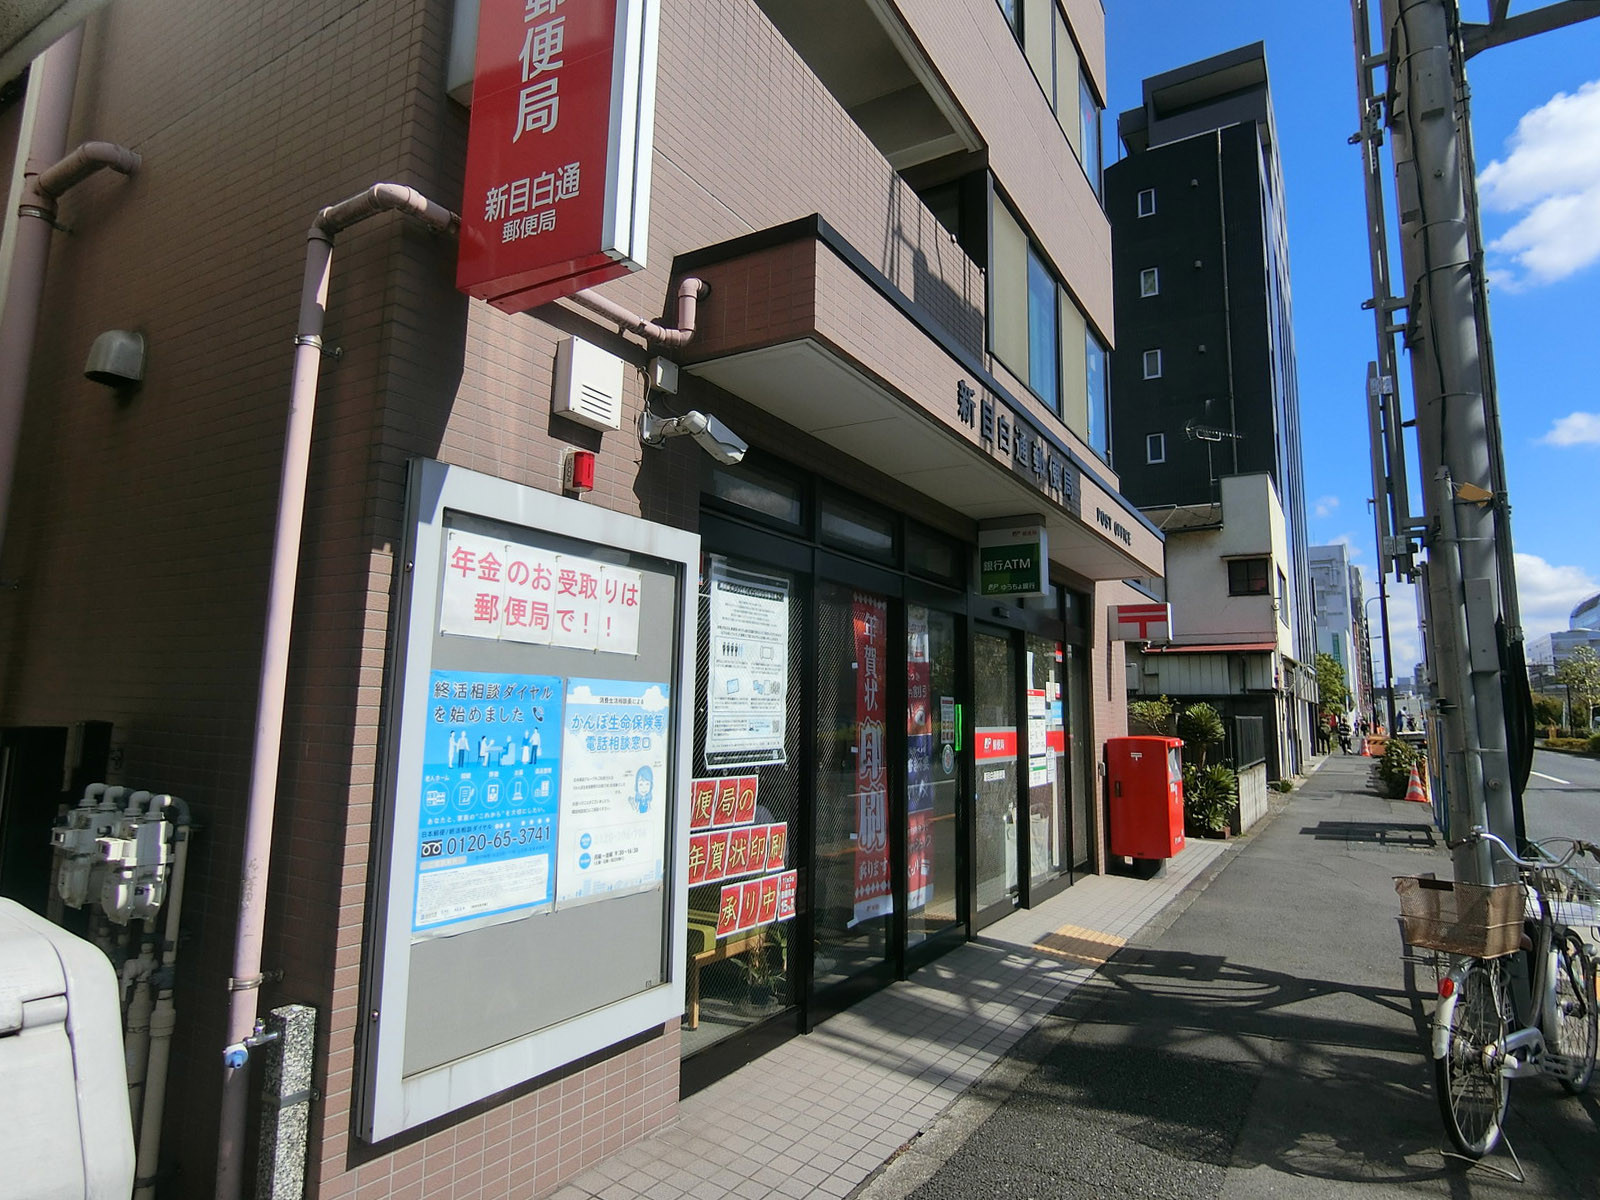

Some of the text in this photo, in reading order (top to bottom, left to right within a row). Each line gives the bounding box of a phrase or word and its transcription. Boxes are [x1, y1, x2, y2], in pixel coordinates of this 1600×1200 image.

[484, 161, 581, 223] 新目白通
[501, 209, 557, 244] 郵便局
[957, 379, 1074, 502] 新目白通郵便局
[1096, 506, 1132, 546] POST OFFICE
[450, 546, 639, 607] 年金のお受取りは
[983, 558, 1031, 571] 銀行ATM
[1000, 582, 1036, 591] ゆうちょ銀行
[433, 680, 553, 701] 終活相談ダイヤル
[434, 706, 524, 723] を始めました
[571, 714, 664, 731] かんぽ生命保険等
[586, 735, 651, 752] 電話相談窓口
[692, 788, 754, 819] 便局の
[447, 826, 551, 855] 0120-65-3741
[689, 832, 785, 876] 年賀状印刷
[720, 887, 775, 926] 承り中
